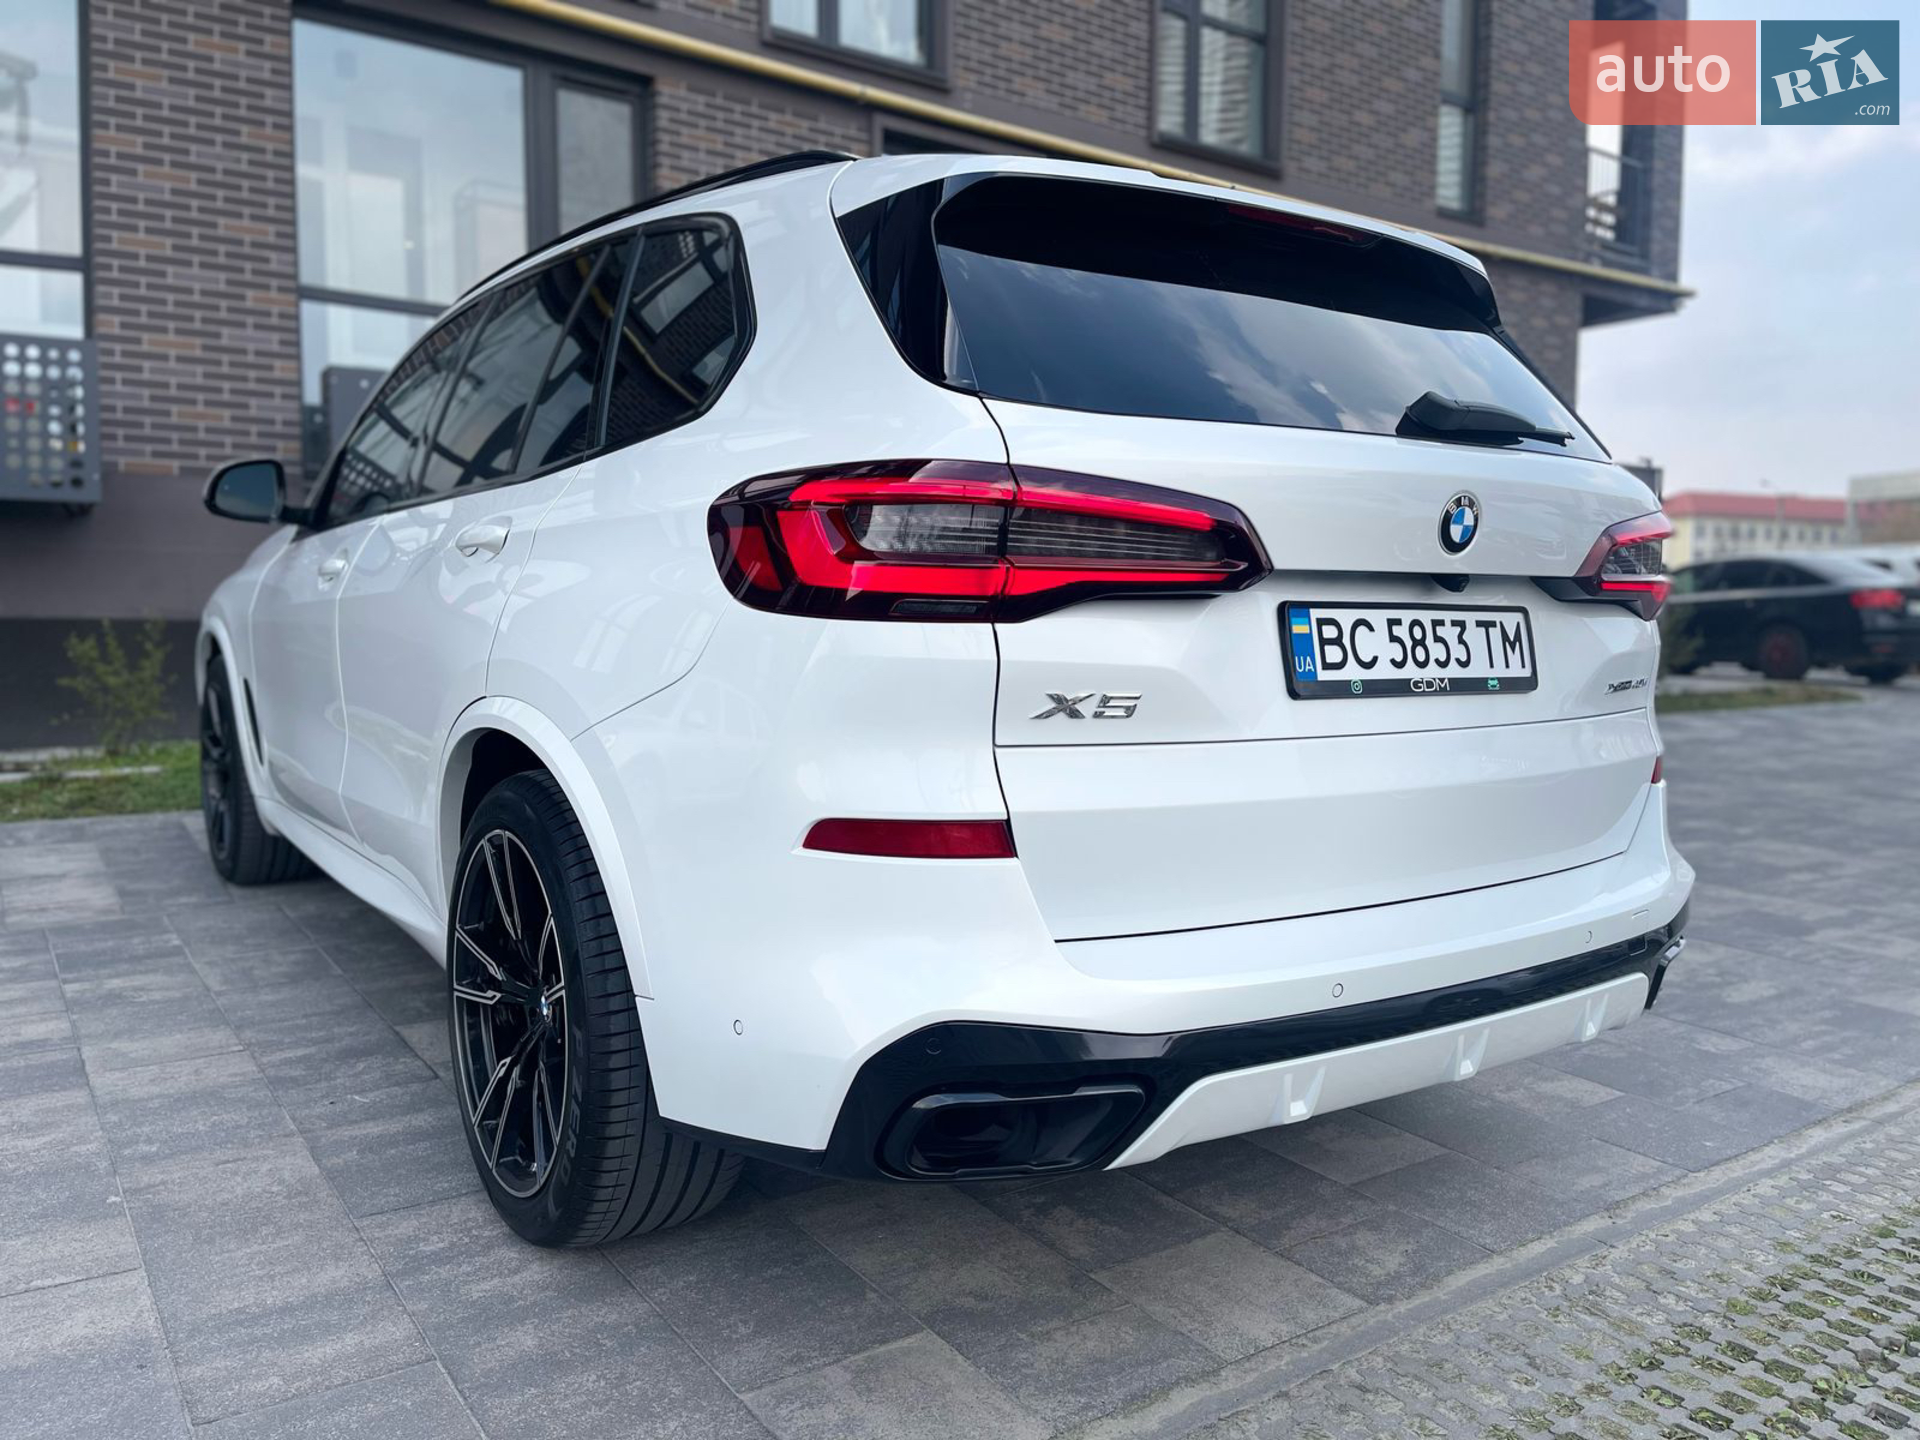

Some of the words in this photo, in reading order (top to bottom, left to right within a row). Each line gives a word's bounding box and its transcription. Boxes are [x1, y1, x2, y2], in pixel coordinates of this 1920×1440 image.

[1315, 617, 1379, 671] BC
[1386, 617, 1472, 670] 5853
[1475, 619, 1527, 669] TM
[1295, 655, 1315, 673] UA
[1410, 677, 1450, 692] GDM
[1029, 691, 1143, 720] X5
